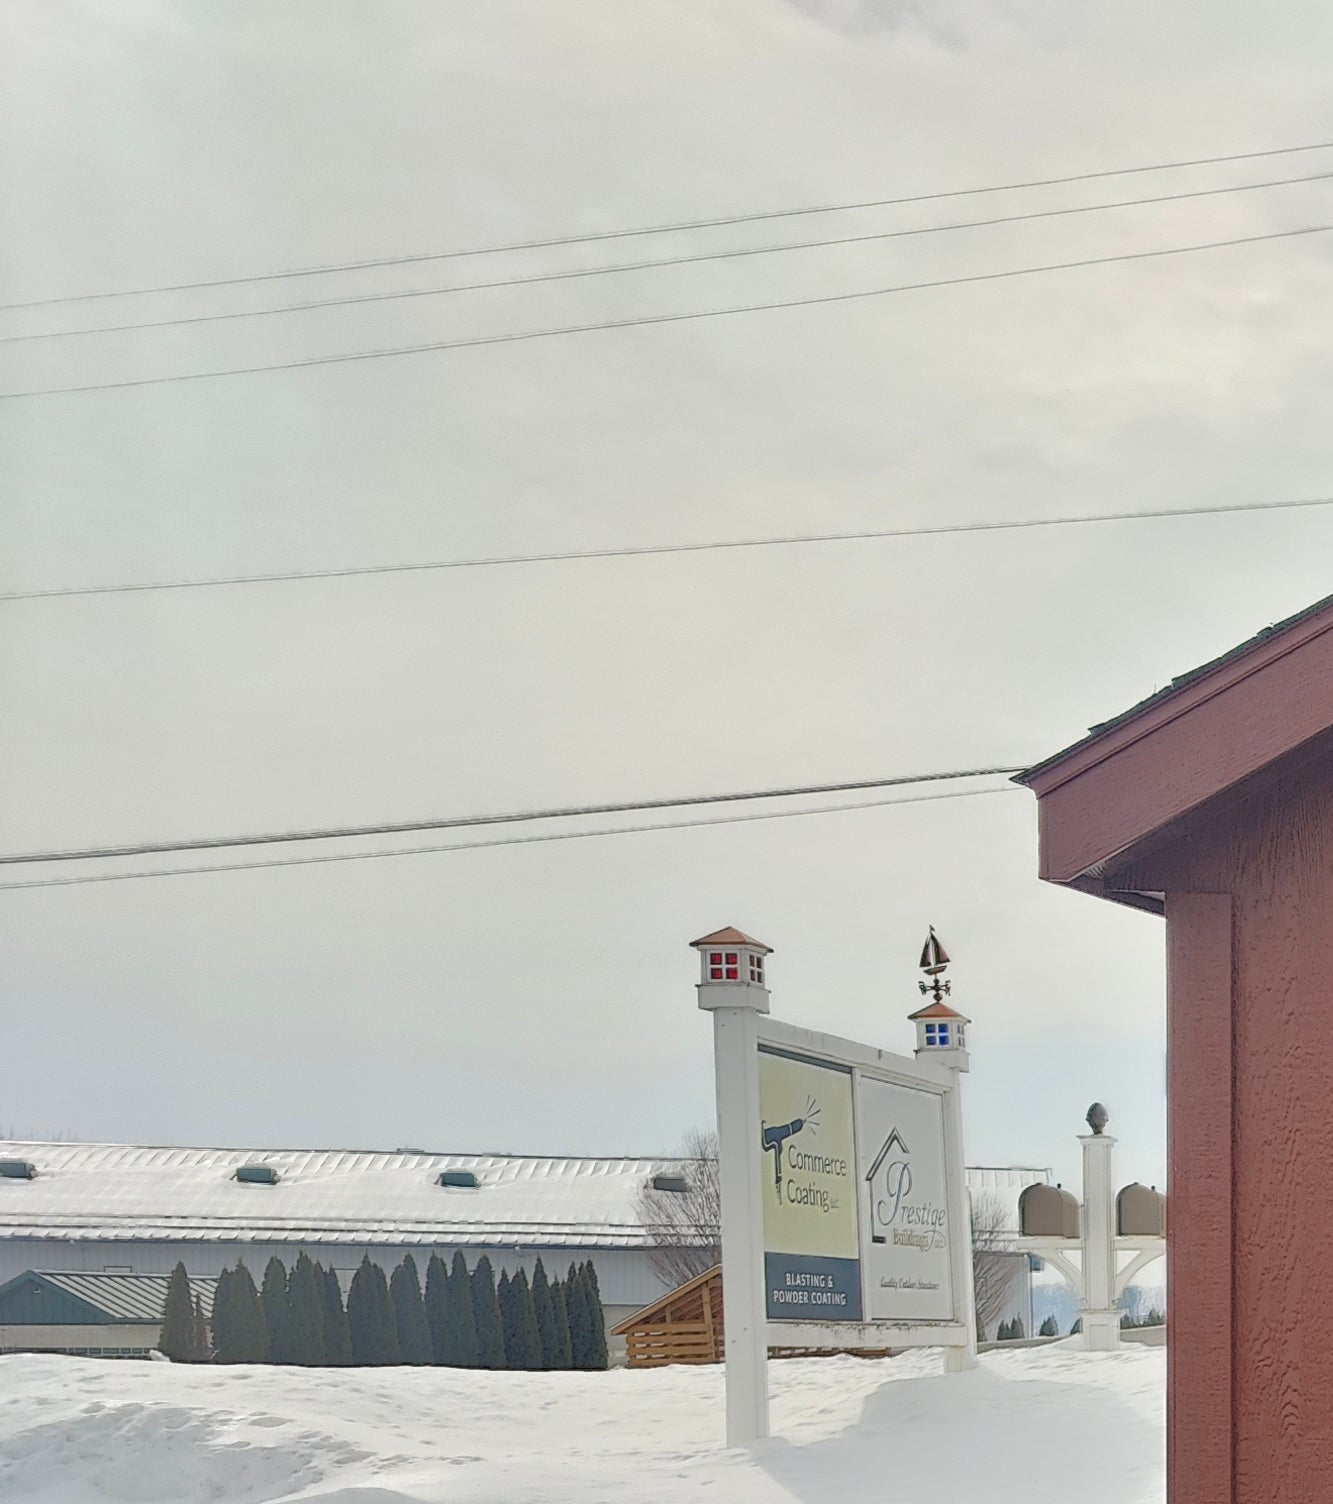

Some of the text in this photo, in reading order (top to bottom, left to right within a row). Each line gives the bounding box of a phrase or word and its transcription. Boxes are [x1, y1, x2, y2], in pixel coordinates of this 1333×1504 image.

[788, 1144, 847, 1177] Commerce
[787, 1179, 830, 1213] Coating
[877, 1161, 946, 1252] Prestige
[785, 1273, 834, 1288] BLASTING &
[773, 1290, 847, 1306] POWDER COATING
